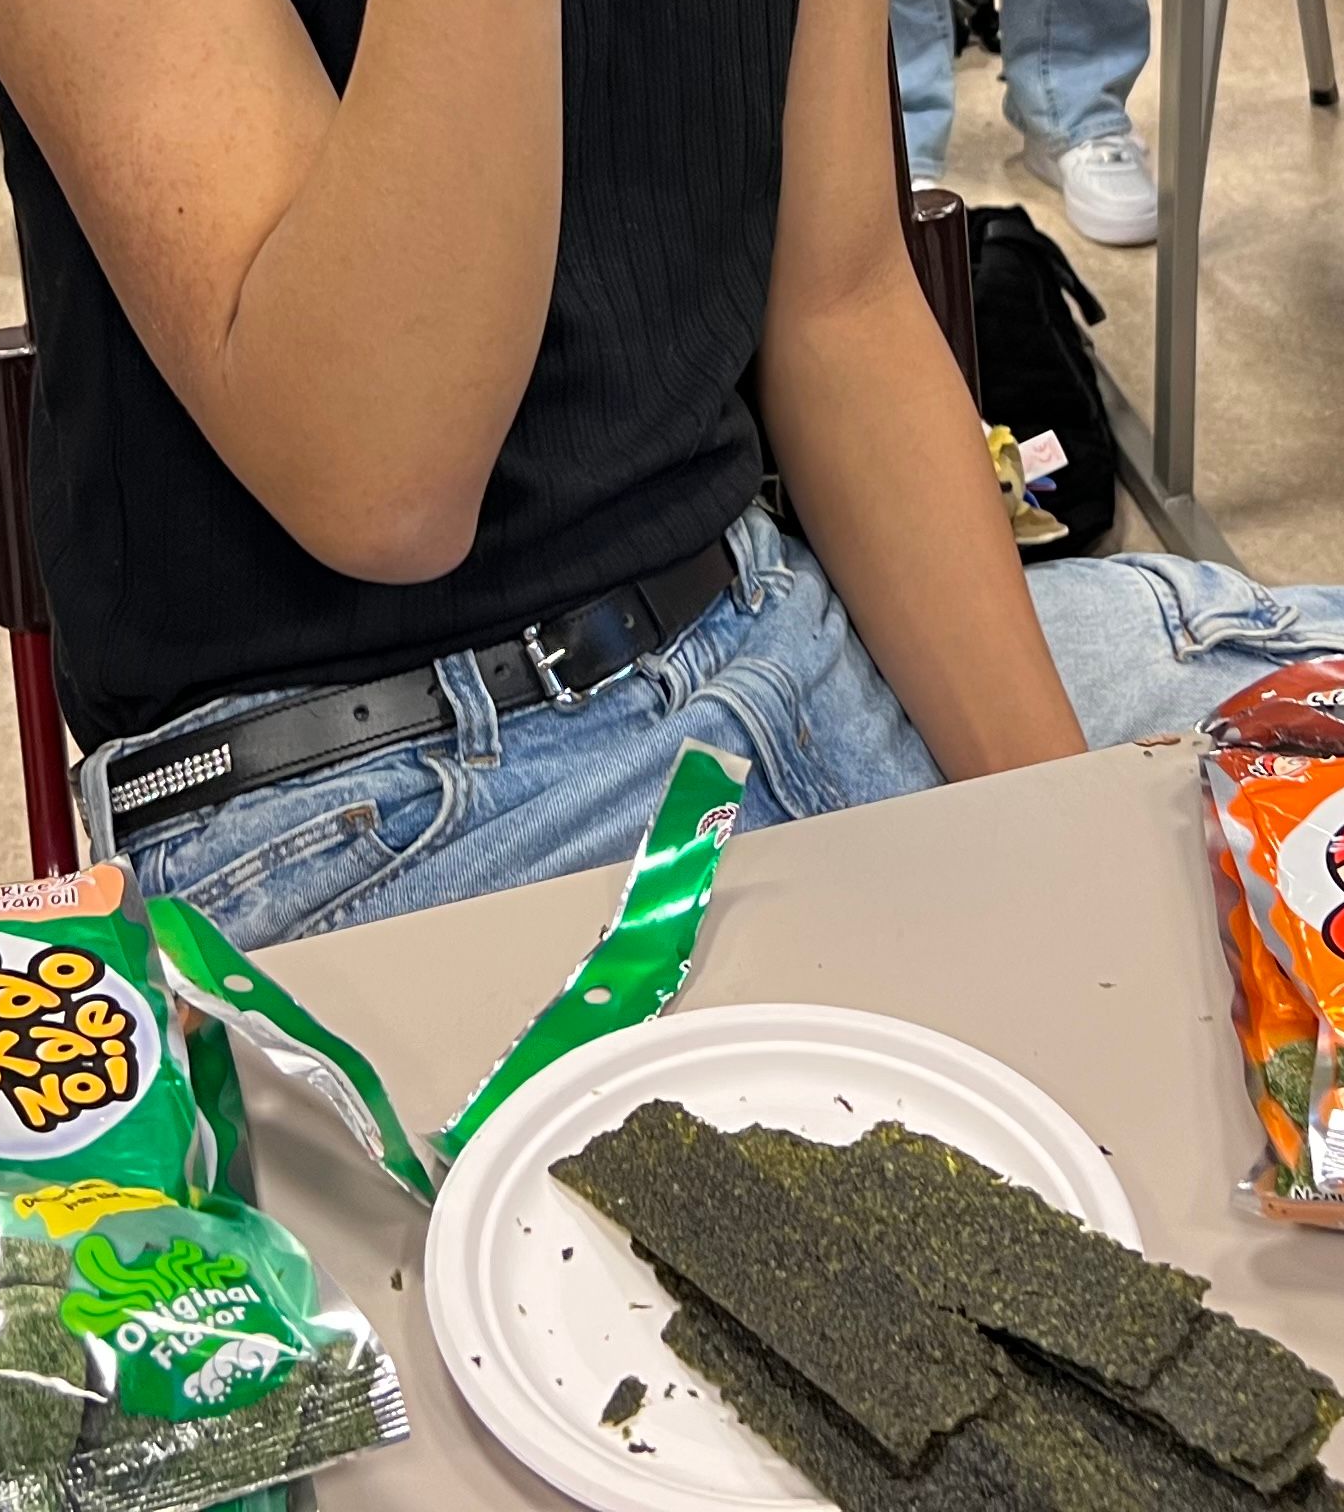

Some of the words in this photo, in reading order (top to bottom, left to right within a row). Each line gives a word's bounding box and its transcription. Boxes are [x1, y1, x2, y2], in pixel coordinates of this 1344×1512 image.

[0, 882, 49, 897] Rice
[50, 887, 76, 905] oil
[12, 1038, 129, 1128] Noi
[116, 1283, 262, 1353] Oiginal
